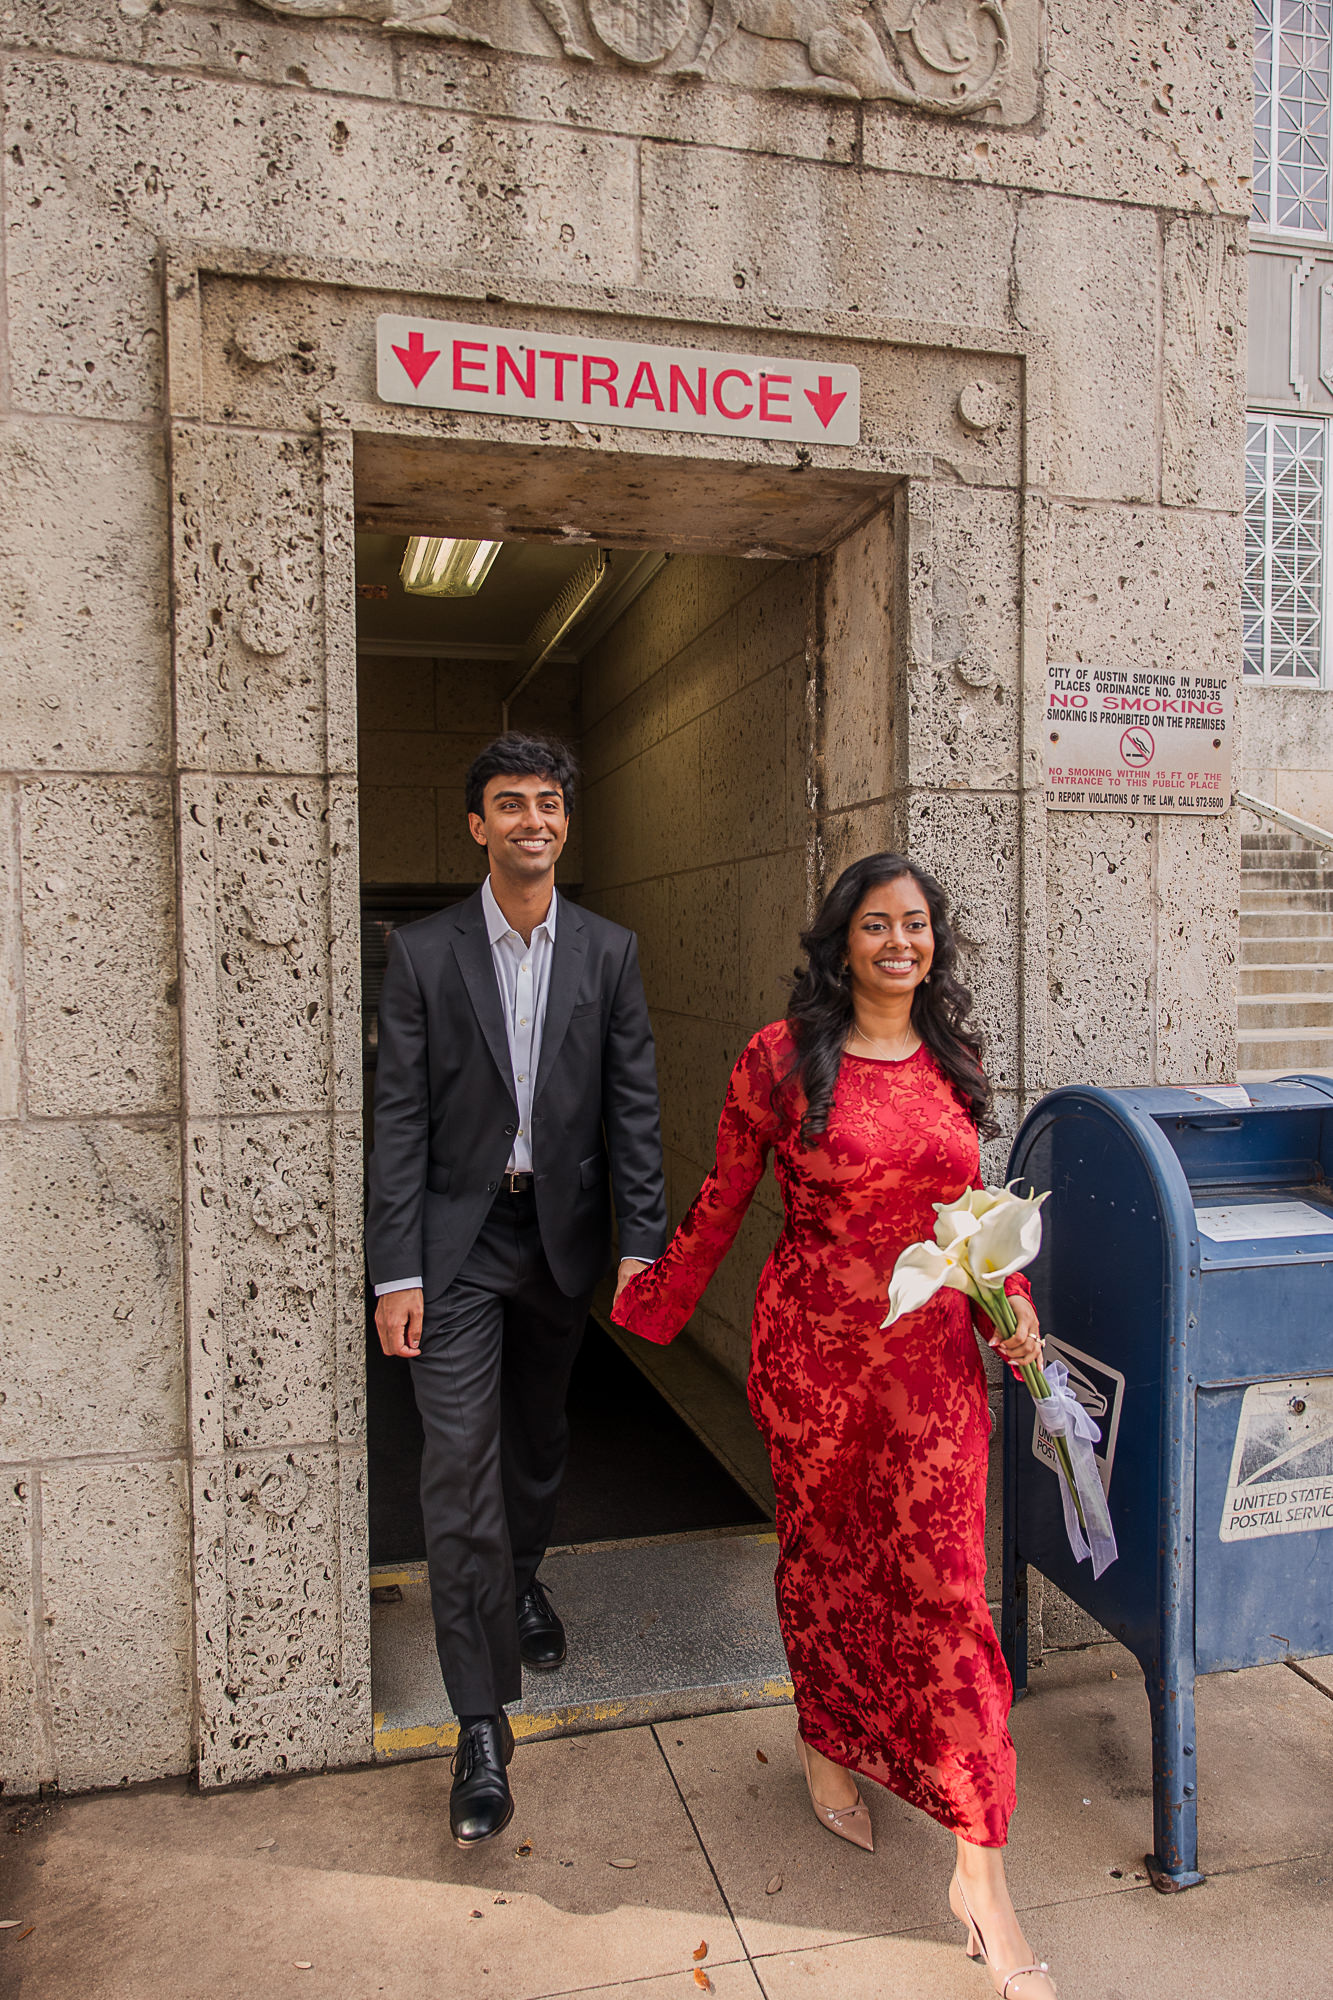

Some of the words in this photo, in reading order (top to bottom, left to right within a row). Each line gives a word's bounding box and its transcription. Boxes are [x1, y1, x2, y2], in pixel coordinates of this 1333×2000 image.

[452, 340, 792, 424] ENTRANCE
[1048, 667, 1071, 678] CITY
[1076, 669, 1088, 680] OF
[1093, 671, 1128, 682] AUSTIN
[1133, 673, 1176, 686] SMOKING
[1180, 676, 1190, 687] IN
[1195, 678, 1227, 689] PUBLIC
[1054, 680, 1091, 692] PLACES
[1096, 683, 1150, 696] ORDINANCE
[1155, 687, 1171, 698] NO.
[1176, 688, 1220, 701] 031030-35
[1050, 694, 1088, 708] NO
[1102, 696, 1224, 715] SMOKING
[1047, 708, 1087, 722] SMOKING
[1089, 711, 1098, 723] IS
[1100, 712, 1149, 726] PROHIBITED
[1152, 715, 1164, 727] ON
[1167, 716, 1183, 728] THE
[1185, 717, 1226, 730] PREMISES
[1048, 767, 1062, 775] NO
[1068, 768, 1112, 777] SMOKING
[1117, 769, 1150, 778] WITHIN
[1156, 771, 1166, 779] 15
[1171, 772, 1182, 780] FT
[1187, 772, 1199, 780] OF
[1204, 773, 1222, 781] THE
[1051, 776, 1103, 786] ENTRANCE
[1109, 778, 1120, 786] TO
[1126, 779, 1147, 787] THIS
[1152, 779, 1185, 788] PUBLIC
[1190, 781, 1219, 789] PLACE
[1045, 791, 1055, 801] TO
[1058, 792, 1085, 803] REPORT
[1088, 793, 1128, 804] VIOLATIONS
[1131, 794, 1140, 805] OF
[1143, 795, 1156, 805] THE
[1159, 795, 1175, 808] LAW,
[1178, 796, 1194, 807] CALL
[1037, 1441, 1057, 1463] POST
[1233, 1492, 1288, 1511] UNITED
[1290, 1486, 1333, 1503] STATE
[1230, 1511, 1283, 1530] POSTAL
[1286, 1504, 1333, 1522] SERVIC
